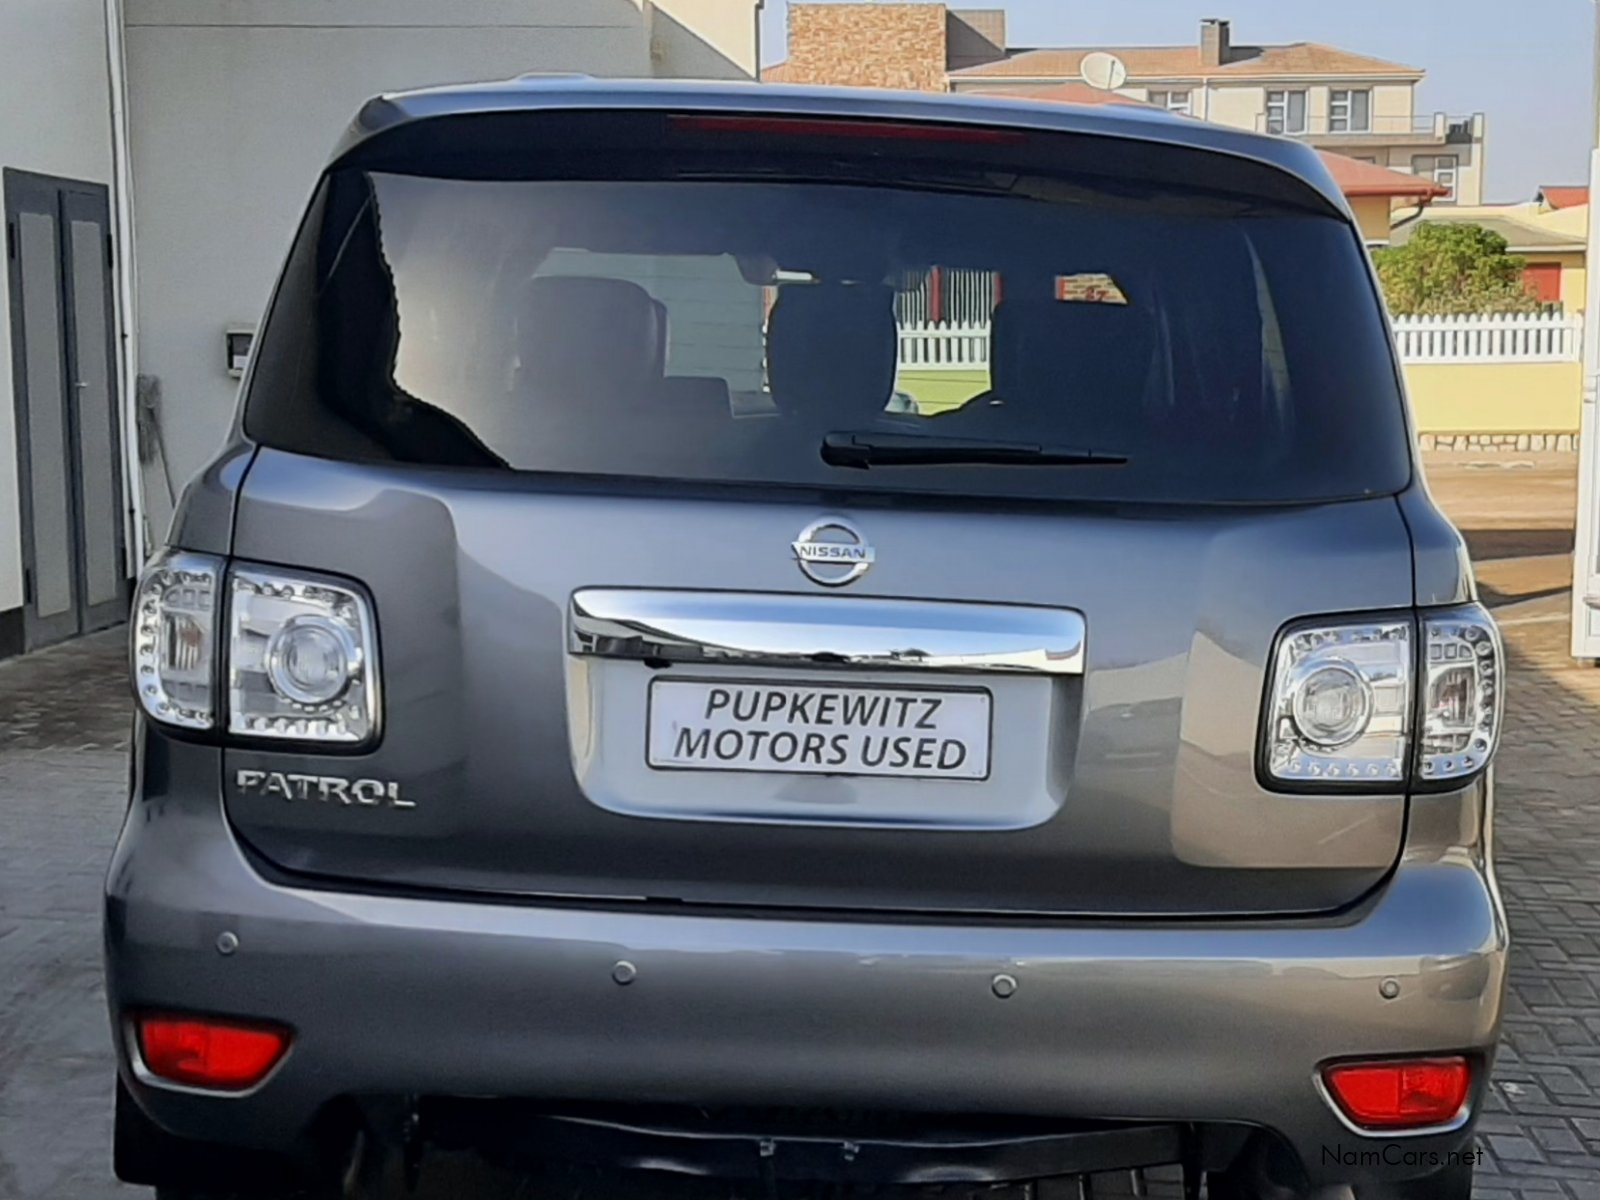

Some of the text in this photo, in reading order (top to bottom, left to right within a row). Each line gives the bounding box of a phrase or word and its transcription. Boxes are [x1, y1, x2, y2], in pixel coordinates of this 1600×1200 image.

[800, 545, 866, 559] NISSAN
[704, 688, 943, 730] PUPKEWITZ
[673, 727, 968, 771] MOTORS USED
[237, 769, 416, 807] PATROL
